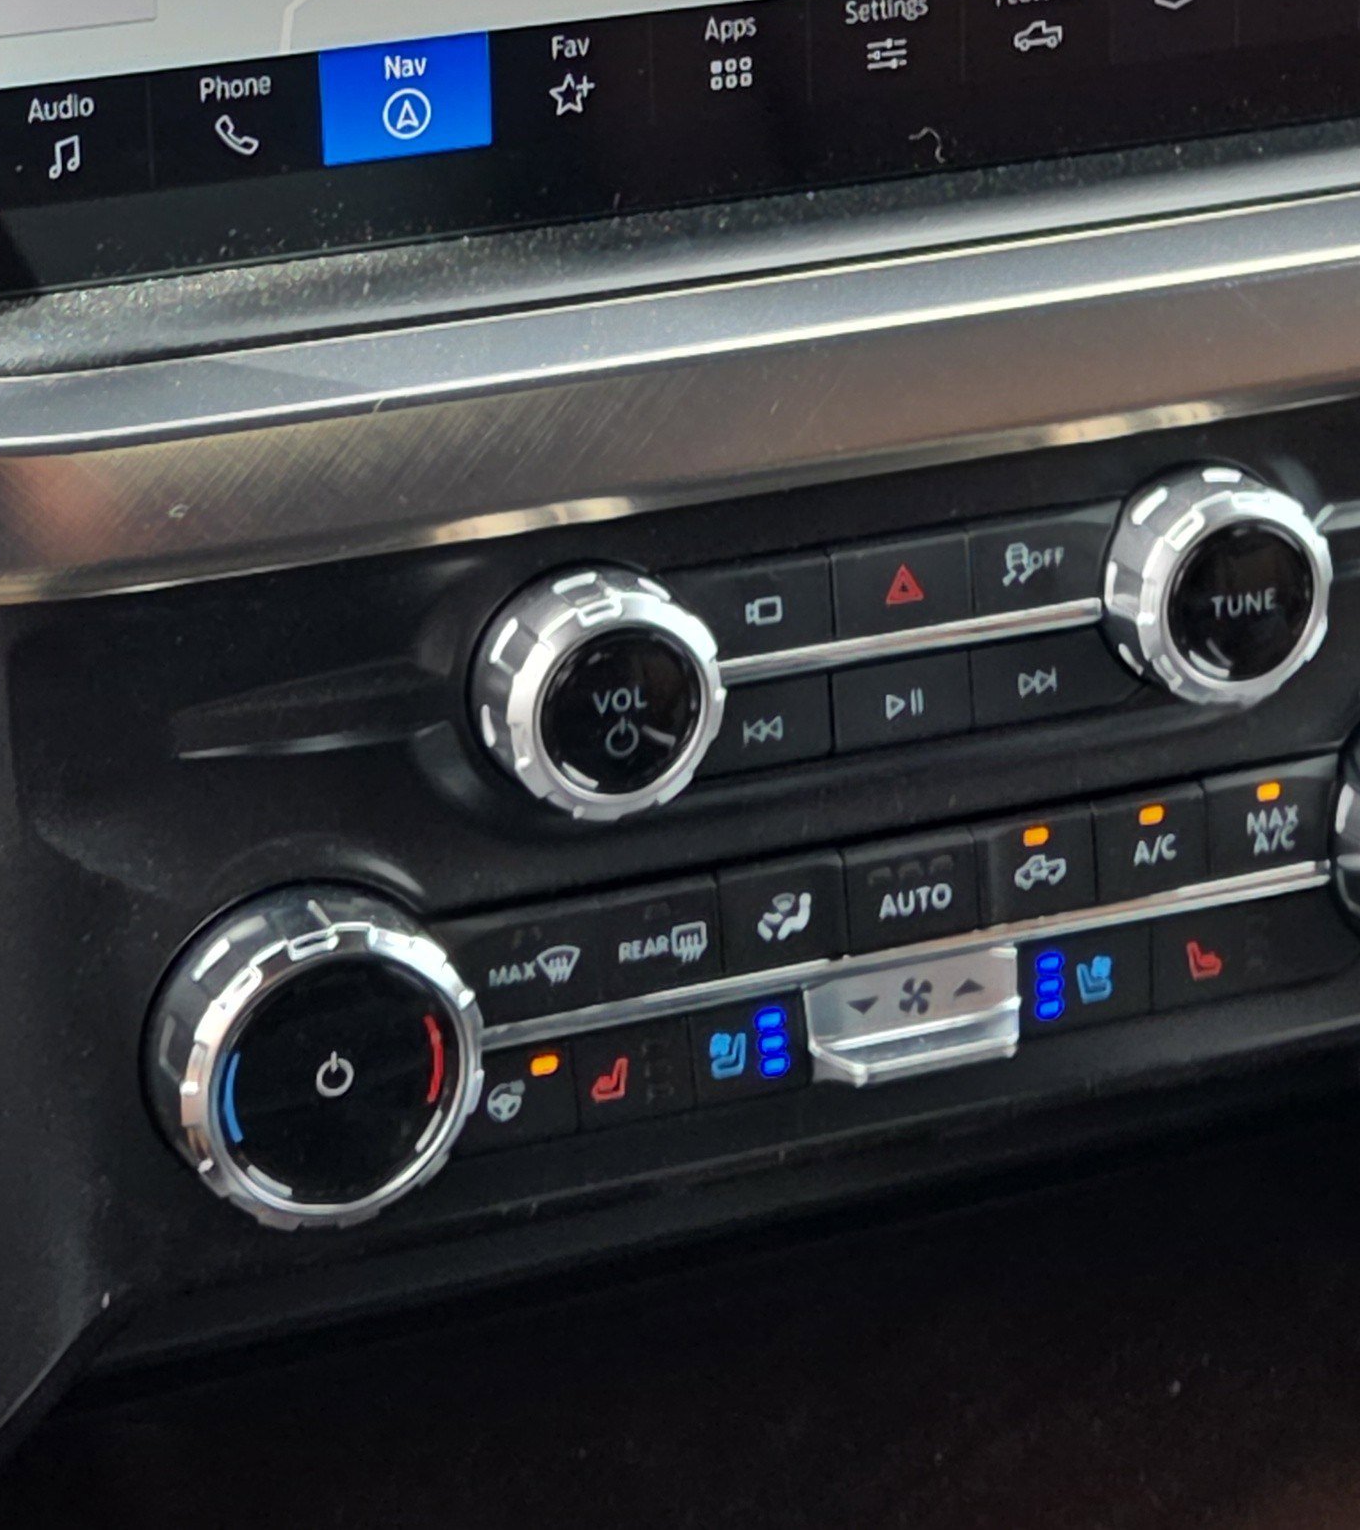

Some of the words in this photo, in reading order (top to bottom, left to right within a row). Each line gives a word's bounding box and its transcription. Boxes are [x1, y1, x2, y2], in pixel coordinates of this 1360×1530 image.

[704, 15, 757, 43] Apps
[551, 33, 590, 61] Fav
[383, 54, 428, 81] Nav
[198, 72, 272, 105] Phone
[27, 92, 95, 124] Audio
[1029, 545, 1065, 570] OFF
[1210, 586, 1279, 622] TUNE
[591, 687, 648, 717] VOL
[1246, 803, 1299, 836] MAX
[1134, 832, 1178, 867] A/C
[1253, 820, 1297, 856] A/C
[879, 882, 954, 923] AUTO
[617, 933, 669, 963] REAR
[488, 960, 538, 987] MAX
